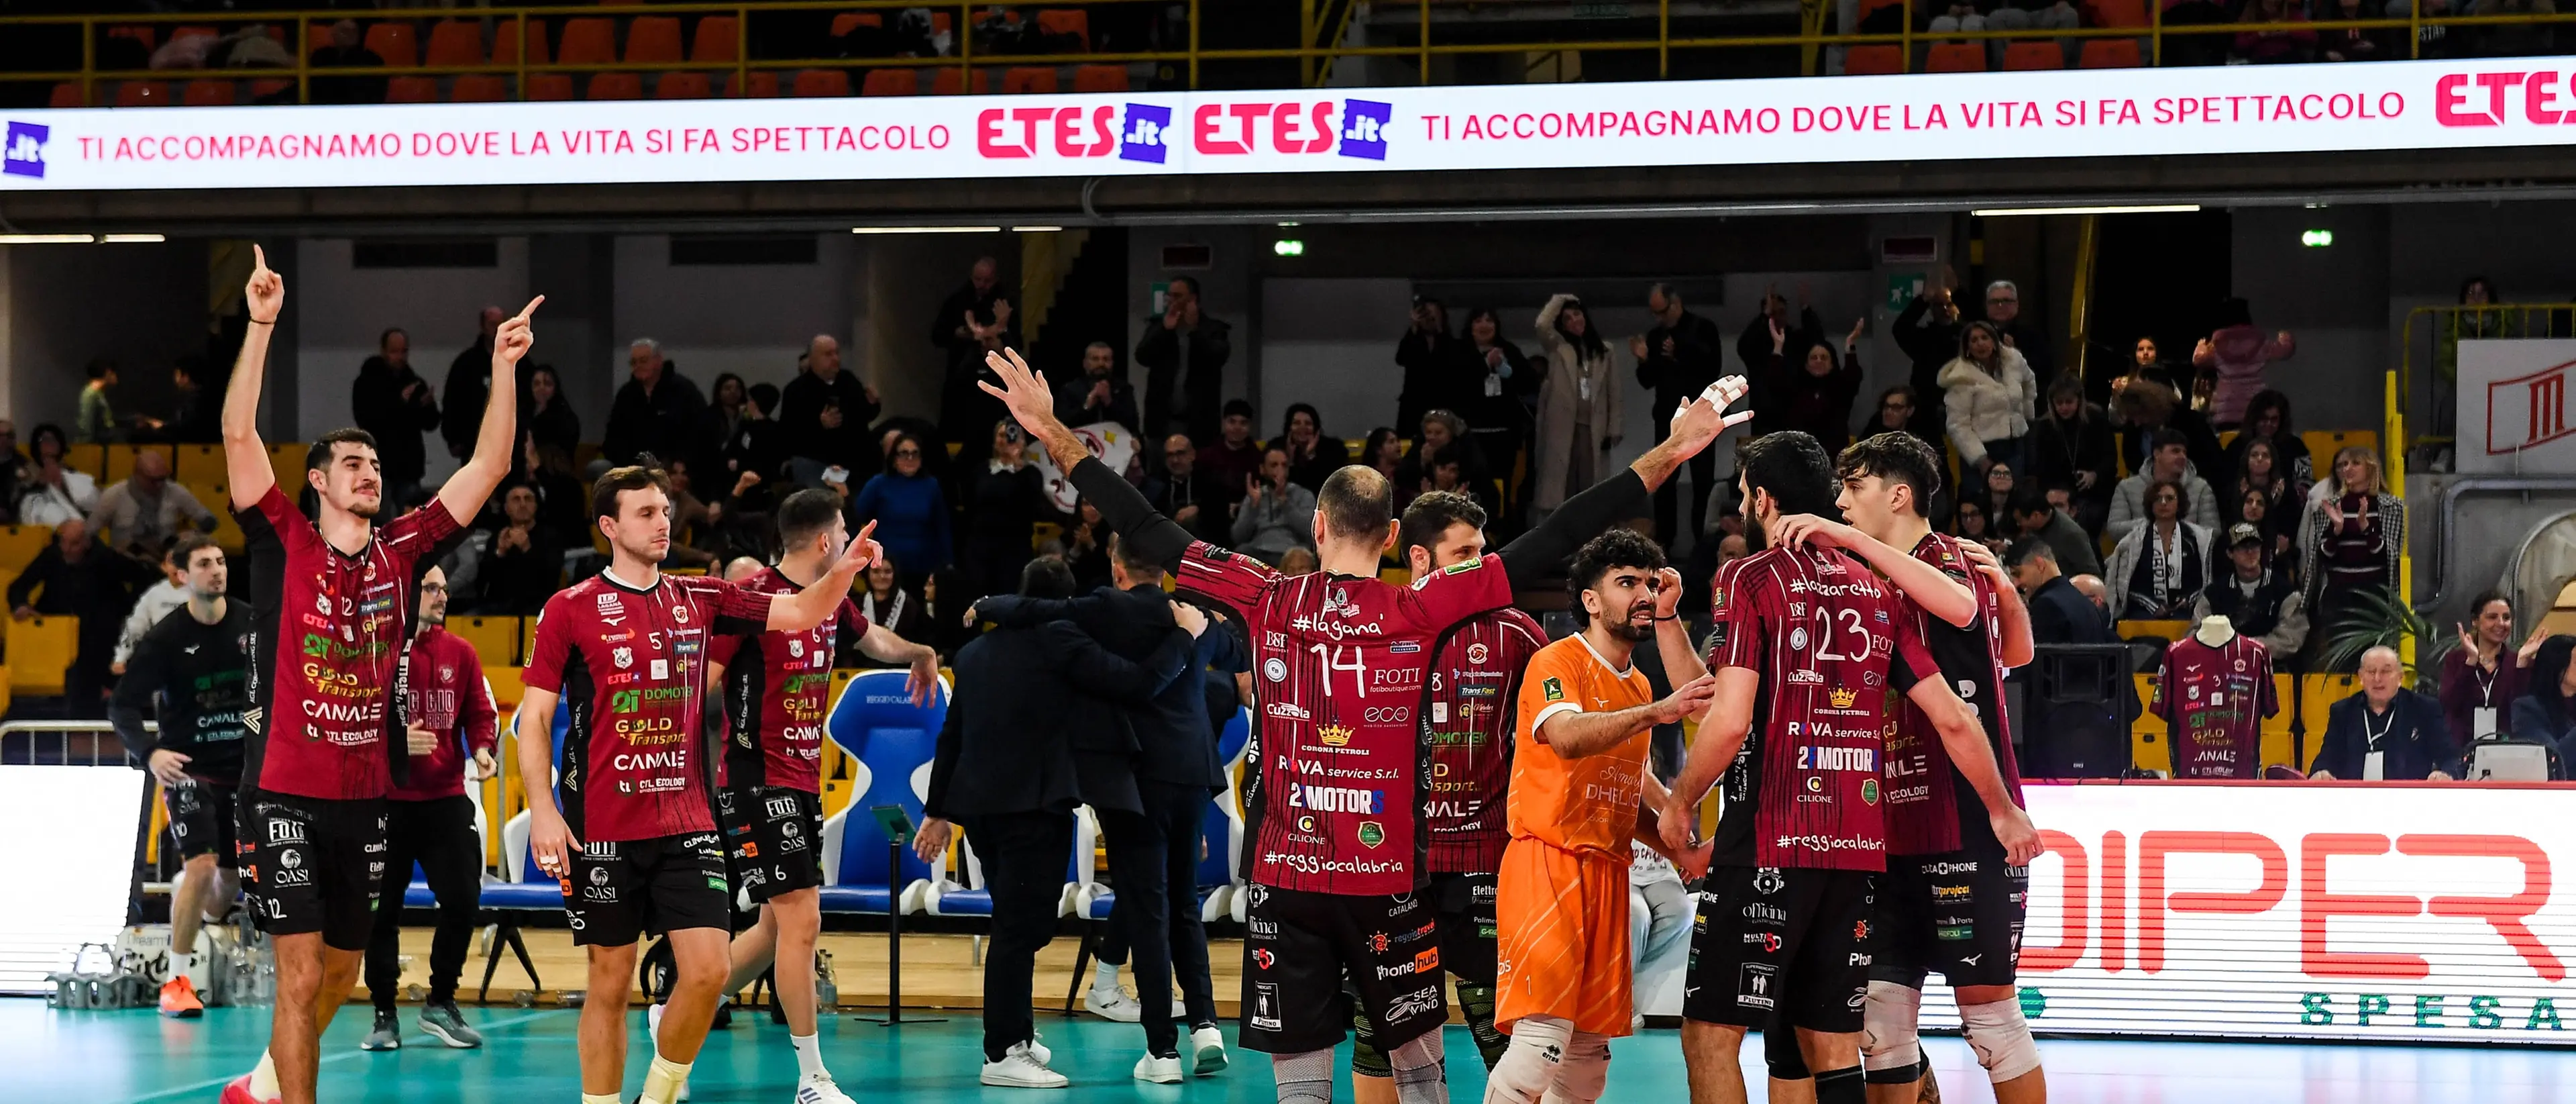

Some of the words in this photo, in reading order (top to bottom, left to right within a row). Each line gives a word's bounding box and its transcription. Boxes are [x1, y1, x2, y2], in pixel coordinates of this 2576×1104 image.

[1420, 115, 1450, 140] TI
[1462, 108, 1780, 140] ACCOMPAGNAMO
[1792, 105, 1890, 133] DOVE
[1903, 104, 1947, 130] LA
[1960, 102, 2042, 128] VITA
[2055, 101, 2085, 126] SI
[2099, 99, 2141, 124] FA
[2153, 92, 2404, 123] SPETTACOLO
[977, 106, 1114, 158] ETES
[1193, 101, 1334, 154] ETES
[79, 138, 102, 157] TI
[115, 134, 400, 159] ACCOMPAGNAMO
[413, 132, 497, 156] DOVE
[511, 132, 549, 154] LA
[561, 130, 633, 154] VITA
[646, 130, 672, 152] SI
[684, 128, 719, 152] FA
[732, 125, 949, 151] SPETTACOLO
[1789, 578, 1882, 599] #lazzaretto
[341, 596, 354, 616] 12
[648, 632, 663, 650] 5
[812, 627, 820, 643] 6
[1815, 605, 1870, 662] 23
[1309, 642, 1367, 699] 14
[1373, 667, 1421, 685] FOTI
[1369, 684, 1421, 693] fotiboutique.com
[1432, 672, 1442, 692] 8
[1461, 687, 1481, 695] Trans
[1481, 687, 1497, 695] Fast
[302, 699, 383, 723] CANALE
[1814, 707, 1840, 715] CORONA
[1834, 728, 1872, 738] service
[1301, 744, 1334, 754] CORONA
[1335, 747, 1370, 756] PETROLI
[613, 750, 687, 771] CANALE
[1327, 768, 1372, 779] service
[1374, 768, 1399, 779] S.r.l.
[1796, 794, 1833, 804] CILIONE
[780, 836, 806, 851] OASI
[1287, 833, 1326, 846] CILIONE
[1776, 833, 1886, 852] #reggiocalabri
[1264, 850, 1404, 874] #reggiocalabria
[1948, 862, 1978, 872] PHONE
[275, 869, 309, 884] OASI
[775, 864, 787, 881] 6
[584, 887, 616, 900] OASI
[267, 897, 287, 919] 12
[1388, 898, 1418, 917] CATALANO
[1416, 950, 1438, 970] hub
[1413, 985, 1438, 1002] SEA
[1525, 974, 1532, 996] 1
[1407, 998, 1438, 1015] WIND
[2300, 992, 2564, 1031] SPESA
